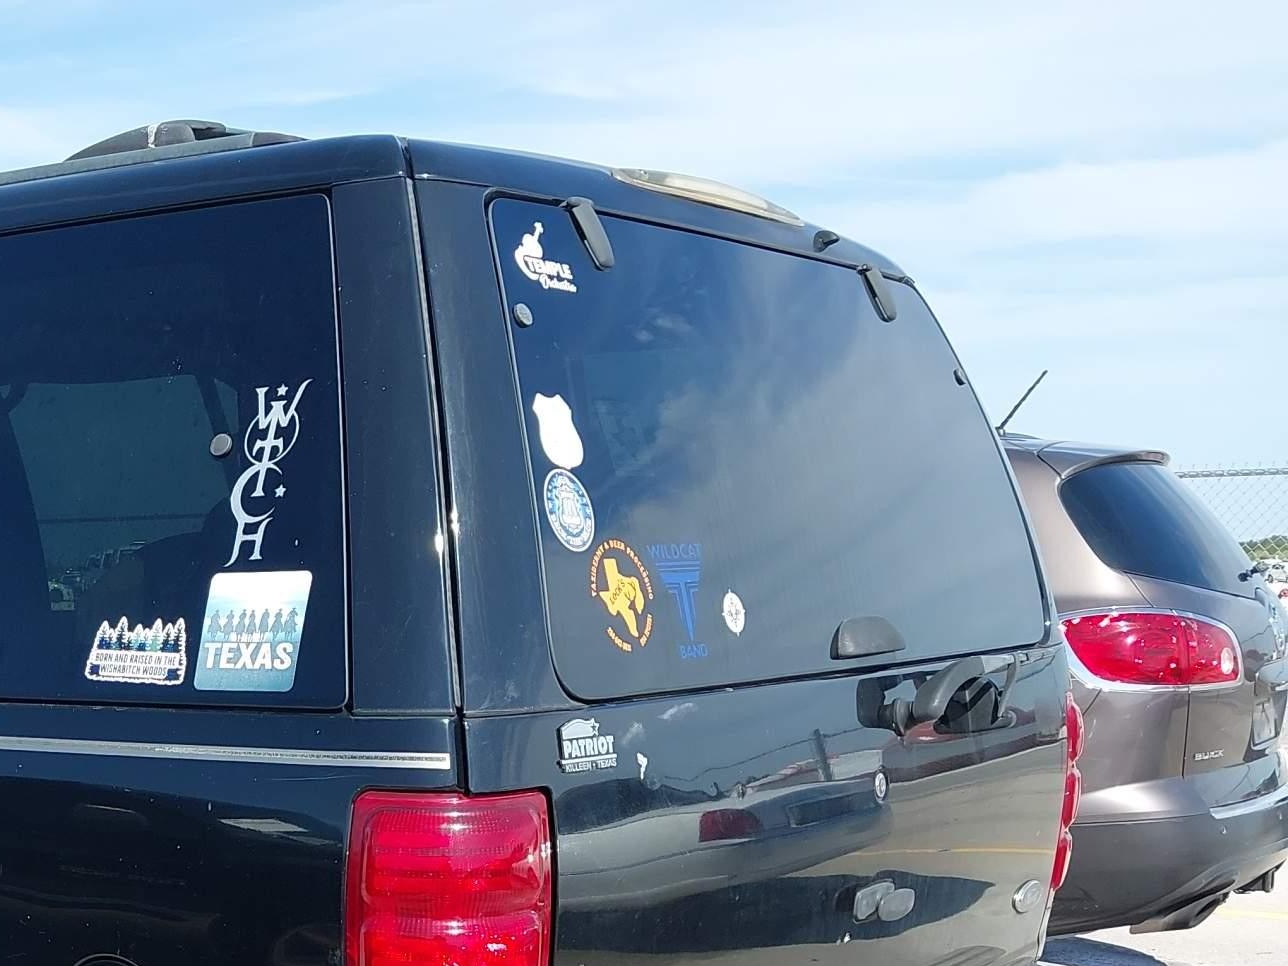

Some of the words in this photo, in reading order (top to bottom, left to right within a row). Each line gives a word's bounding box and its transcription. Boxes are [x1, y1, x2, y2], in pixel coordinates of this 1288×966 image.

[522, 255, 574, 280] TEMPLE
[223, 378, 314, 568] WITCH
[647, 543, 701, 559] WILDCAT
[95, 652, 113, 663] BORN
[114, 652, 129, 664] AND
[130, 653, 153, 665] RAISED
[154, 655, 162, 665] IN
[162, 656, 177, 666] THE
[204, 641, 294, 671] TEXAS
[679, 644, 709, 659] BAND
[99, 663, 141, 675] WISHABITCH
[142, 665, 168, 677] WOODS
[563, 735, 614, 759] PATRIOT
[1194, 748, 1225, 761] BUICK
[565, 761, 592, 773] KILLEEN
[596, 758, 617, 769] TEXAS
